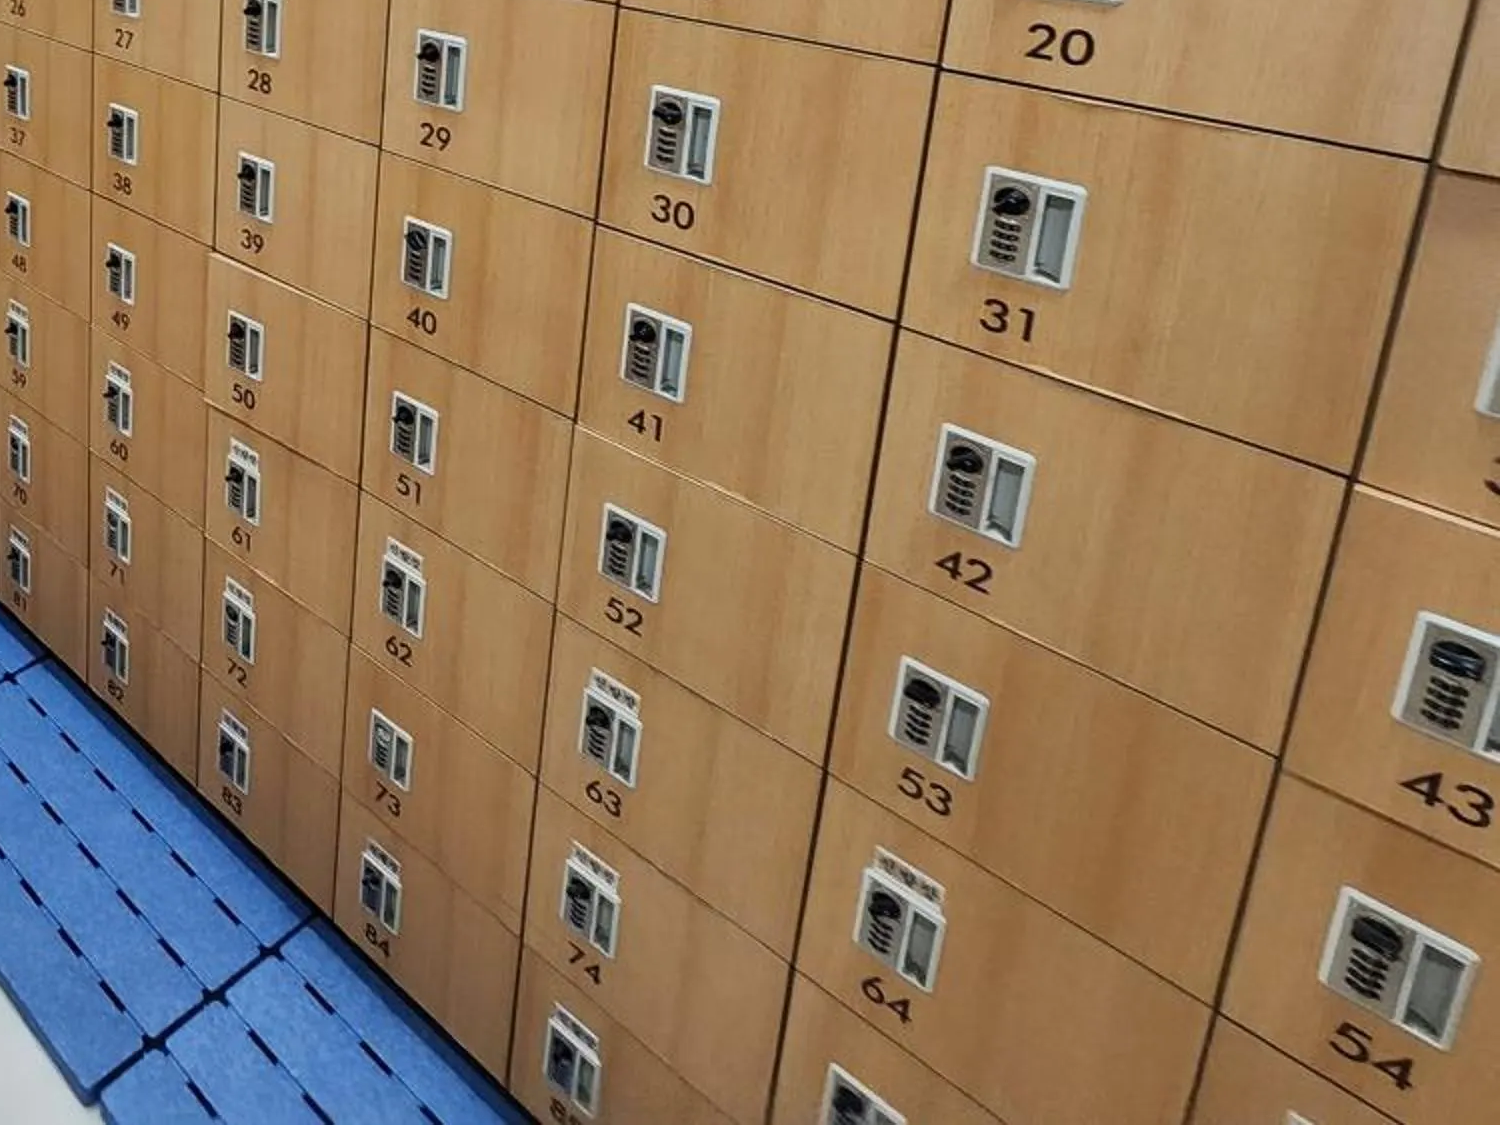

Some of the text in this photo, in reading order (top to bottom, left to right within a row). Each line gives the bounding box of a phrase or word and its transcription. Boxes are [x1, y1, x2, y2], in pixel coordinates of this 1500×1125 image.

[115, 29, 134, 49] 27
[1025, 22, 1095, 66] 20
[247, 69, 272, 95] 28
[419, 122, 451, 152] 29
[113, 172, 132, 195] 38
[650, 193, 695, 231] 30
[240, 229, 264, 255] 39
[112, 311, 131, 331] 49
[406, 307, 437, 336] 40
[978, 298, 1038, 343] 31
[231, 383, 256, 410] 50
[627, 409, 664, 442] 41
[110, 439, 128, 461] 60
[395, 474, 422, 506] 51
[231, 526, 252, 552] 61
[109, 563, 125, 585] 71
[935, 550, 993, 596] 42
[604, 599, 644, 638] 52
[384, 635, 414, 668] 62
[227, 658, 248, 690] 72
[221, 786, 244, 816] 83
[374, 781, 402, 817] 73
[584, 779, 623, 818] 63
[897, 767, 954, 817] 53
[1397, 772, 1496, 829] 43
[364, 923, 391, 959] 84
[567, 943, 602, 985] 74
[861, 976, 913, 1024] 64
[1328, 1022, 1415, 1091] 54
